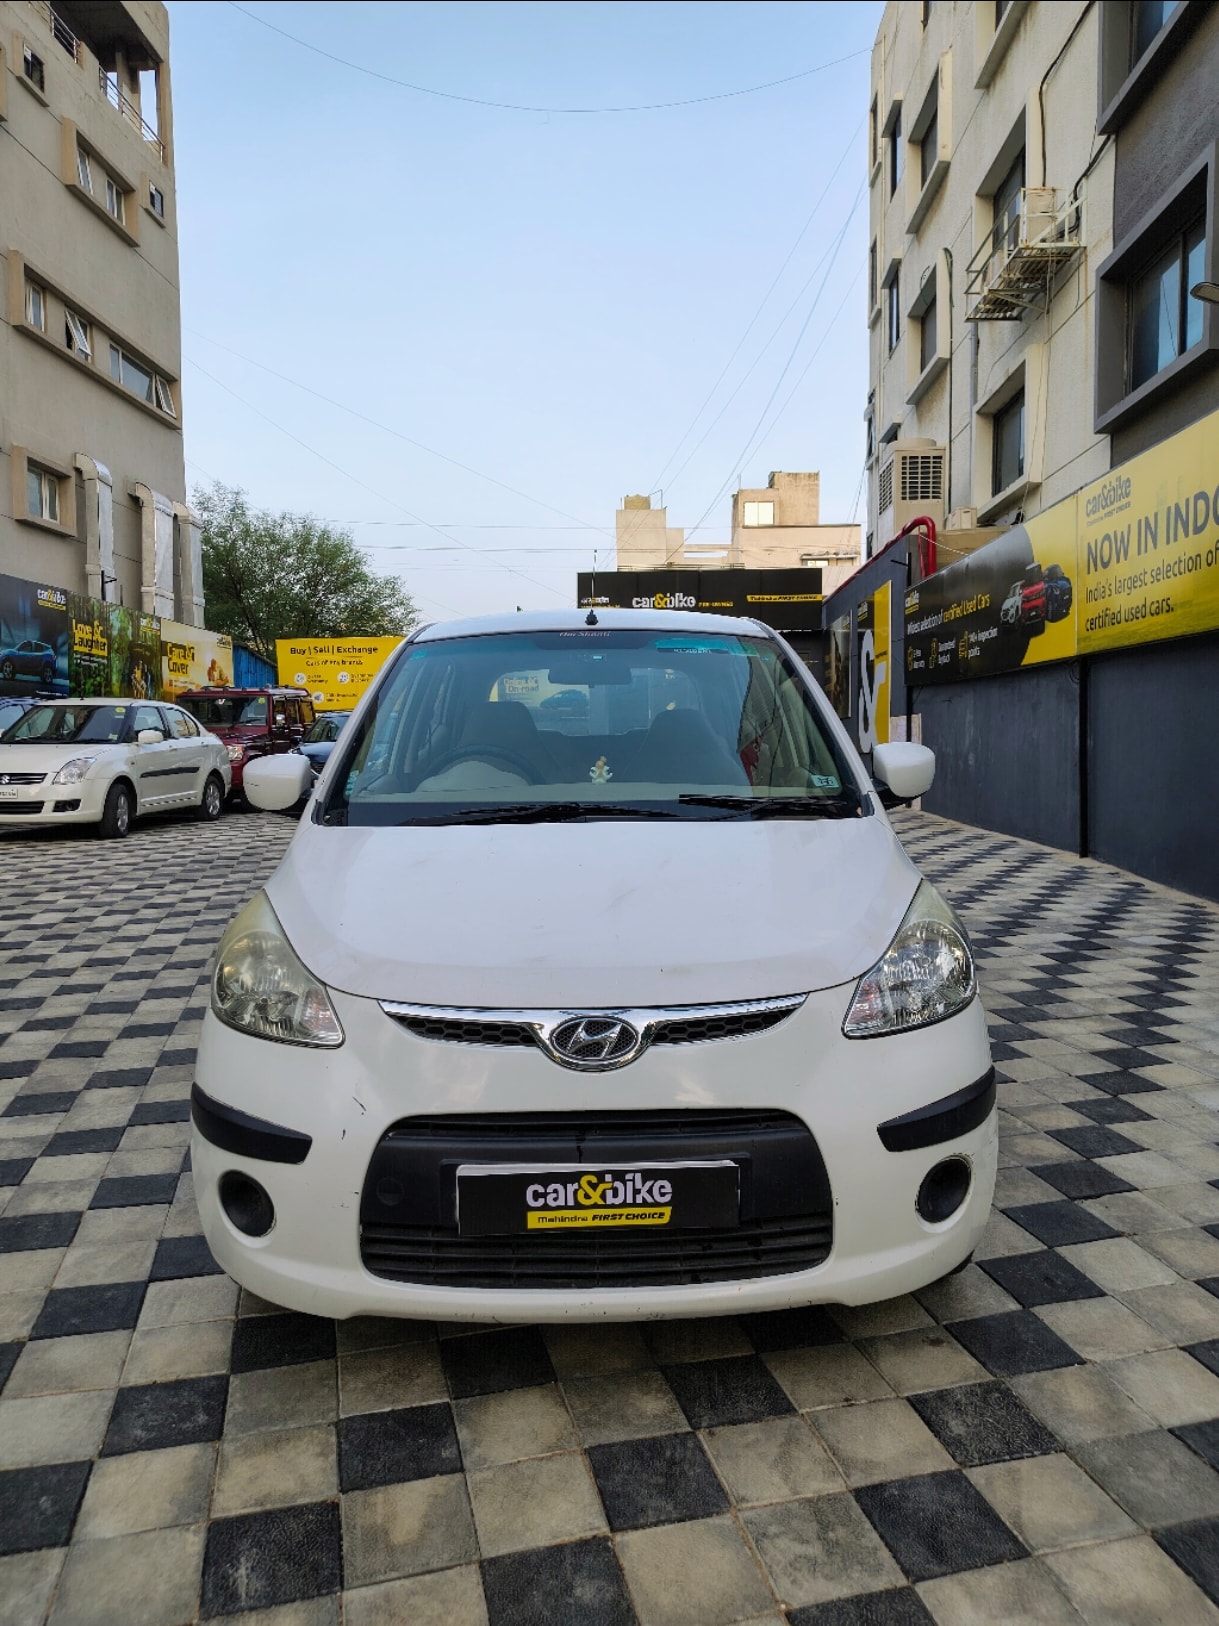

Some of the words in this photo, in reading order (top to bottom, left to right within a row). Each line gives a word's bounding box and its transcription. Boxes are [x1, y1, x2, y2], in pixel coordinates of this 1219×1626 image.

[1086, 475, 1132, 517] car&bike
[1087, 523, 1131, 575] NOW
[1137, 511, 1158, 556] IN
[1086, 578, 1112, 604] India's
[1115, 567, 1148, 597] largest
[1150, 552, 1202, 583] selection
[632, 593, 696, 609] car&bike
[977, 593, 991, 609] Cars
[1085, 604, 1122, 632] certified
[1124, 596, 1147, 622] used
[1149, 597, 1174, 617] cars.
[72, 619, 92, 635] Love
[74, 631, 107, 652] Laughter
[290, 647, 306, 656] Buy
[313, 645, 330, 654] Sell
[336, 645, 378, 655] Exchange
[168, 658, 189, 675] Cover
[526, 1173, 673, 1207] car&bike
[591, 1213, 623, 1221] FIRST
[625, 1212, 666, 1220] CHOICE
